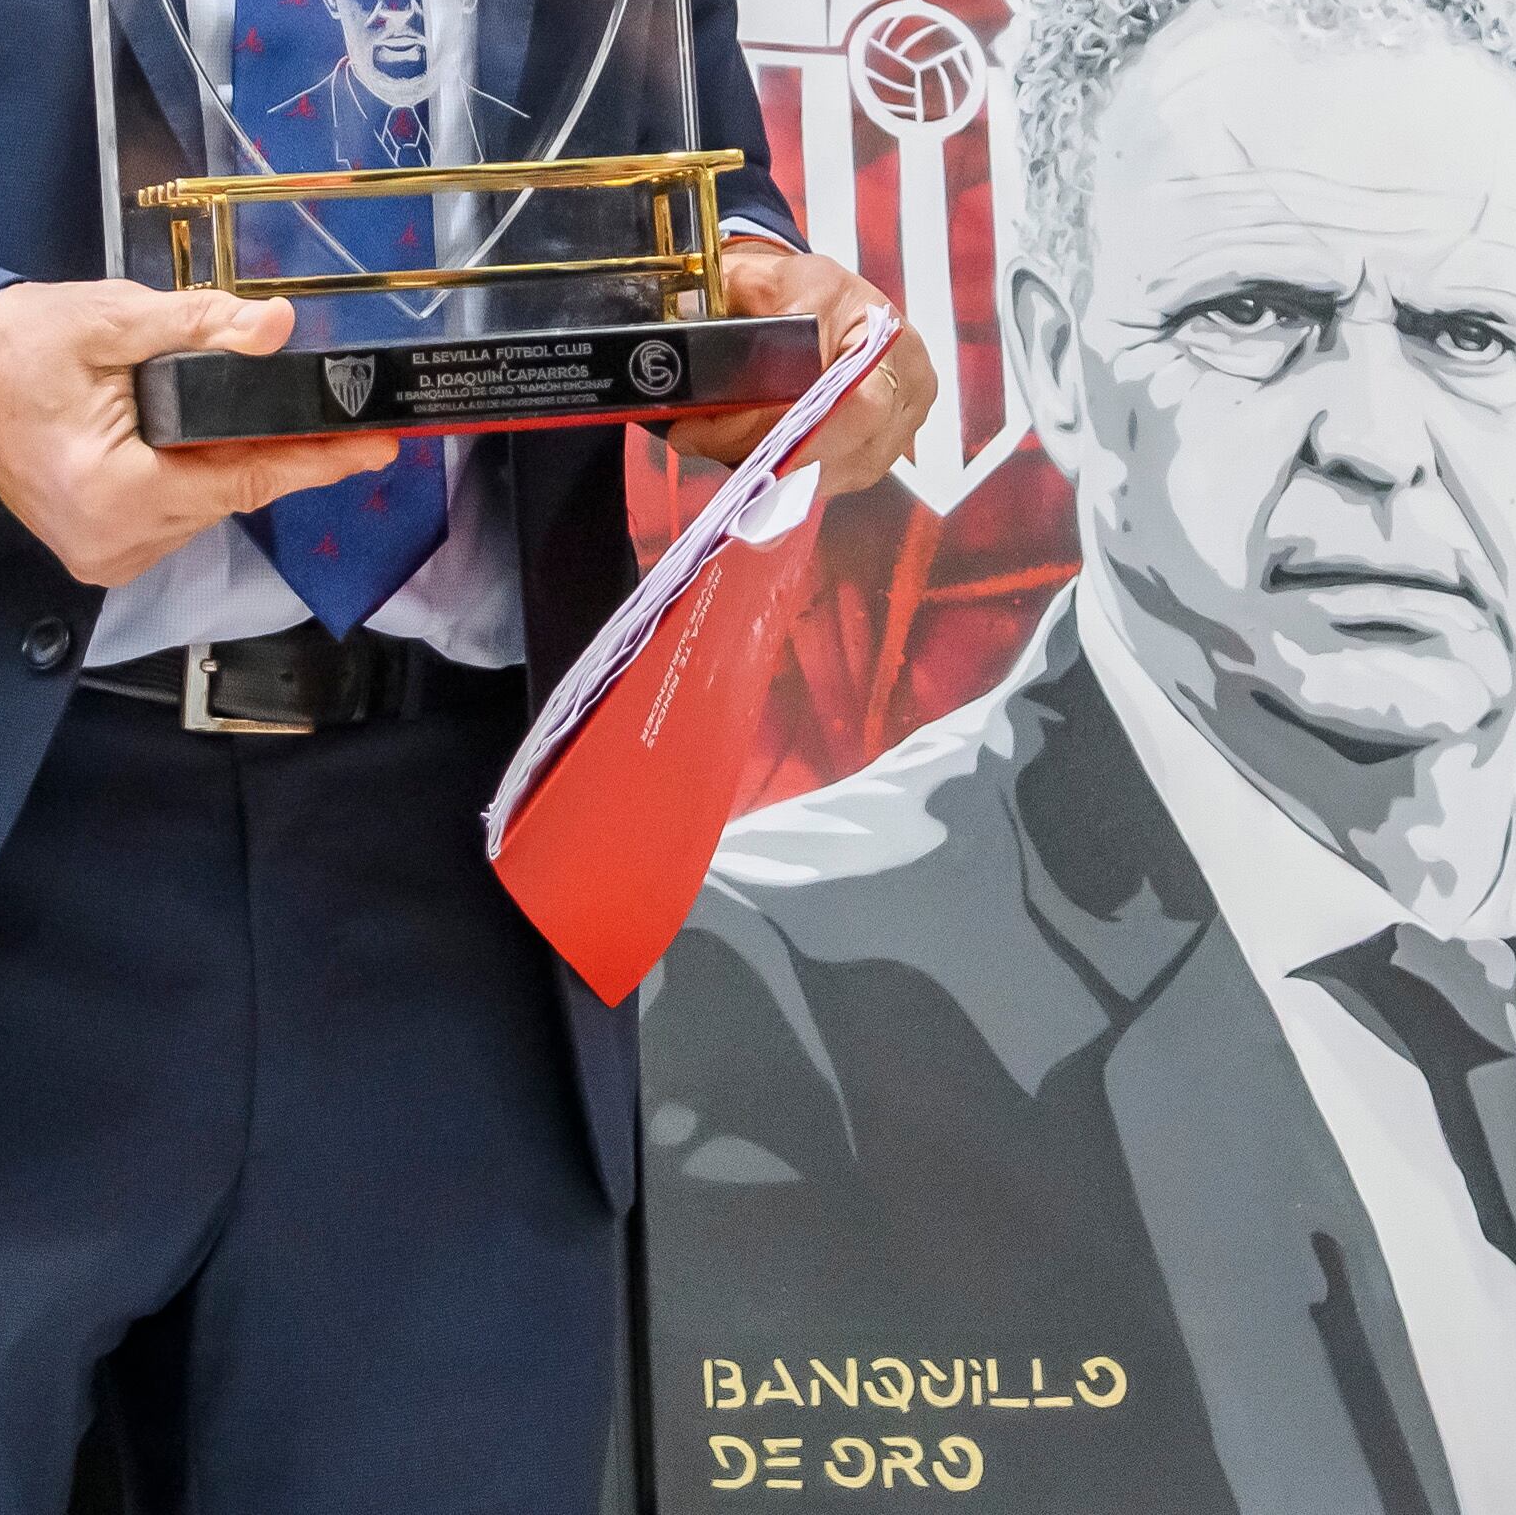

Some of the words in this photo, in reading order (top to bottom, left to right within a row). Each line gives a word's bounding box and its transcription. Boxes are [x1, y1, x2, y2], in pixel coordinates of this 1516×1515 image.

[412, 351, 430, 365] EL
[431, 348, 491, 364] SEVILLA
[554, 342, 593, 357] CLUB
[500, 360, 508, 370] A
[419, 374, 435, 388] D.
[436, 369, 504, 388] JOAQUÍN
[506, 364, 589, 382] CAPARRÓS
[404, 387, 470, 401] BANQUILLO
[702, 1355, 1128, 1412] BANQUILLO
[708, 1435, 804, 1490] DE
[823, 1435, 985, 1492] ORO
